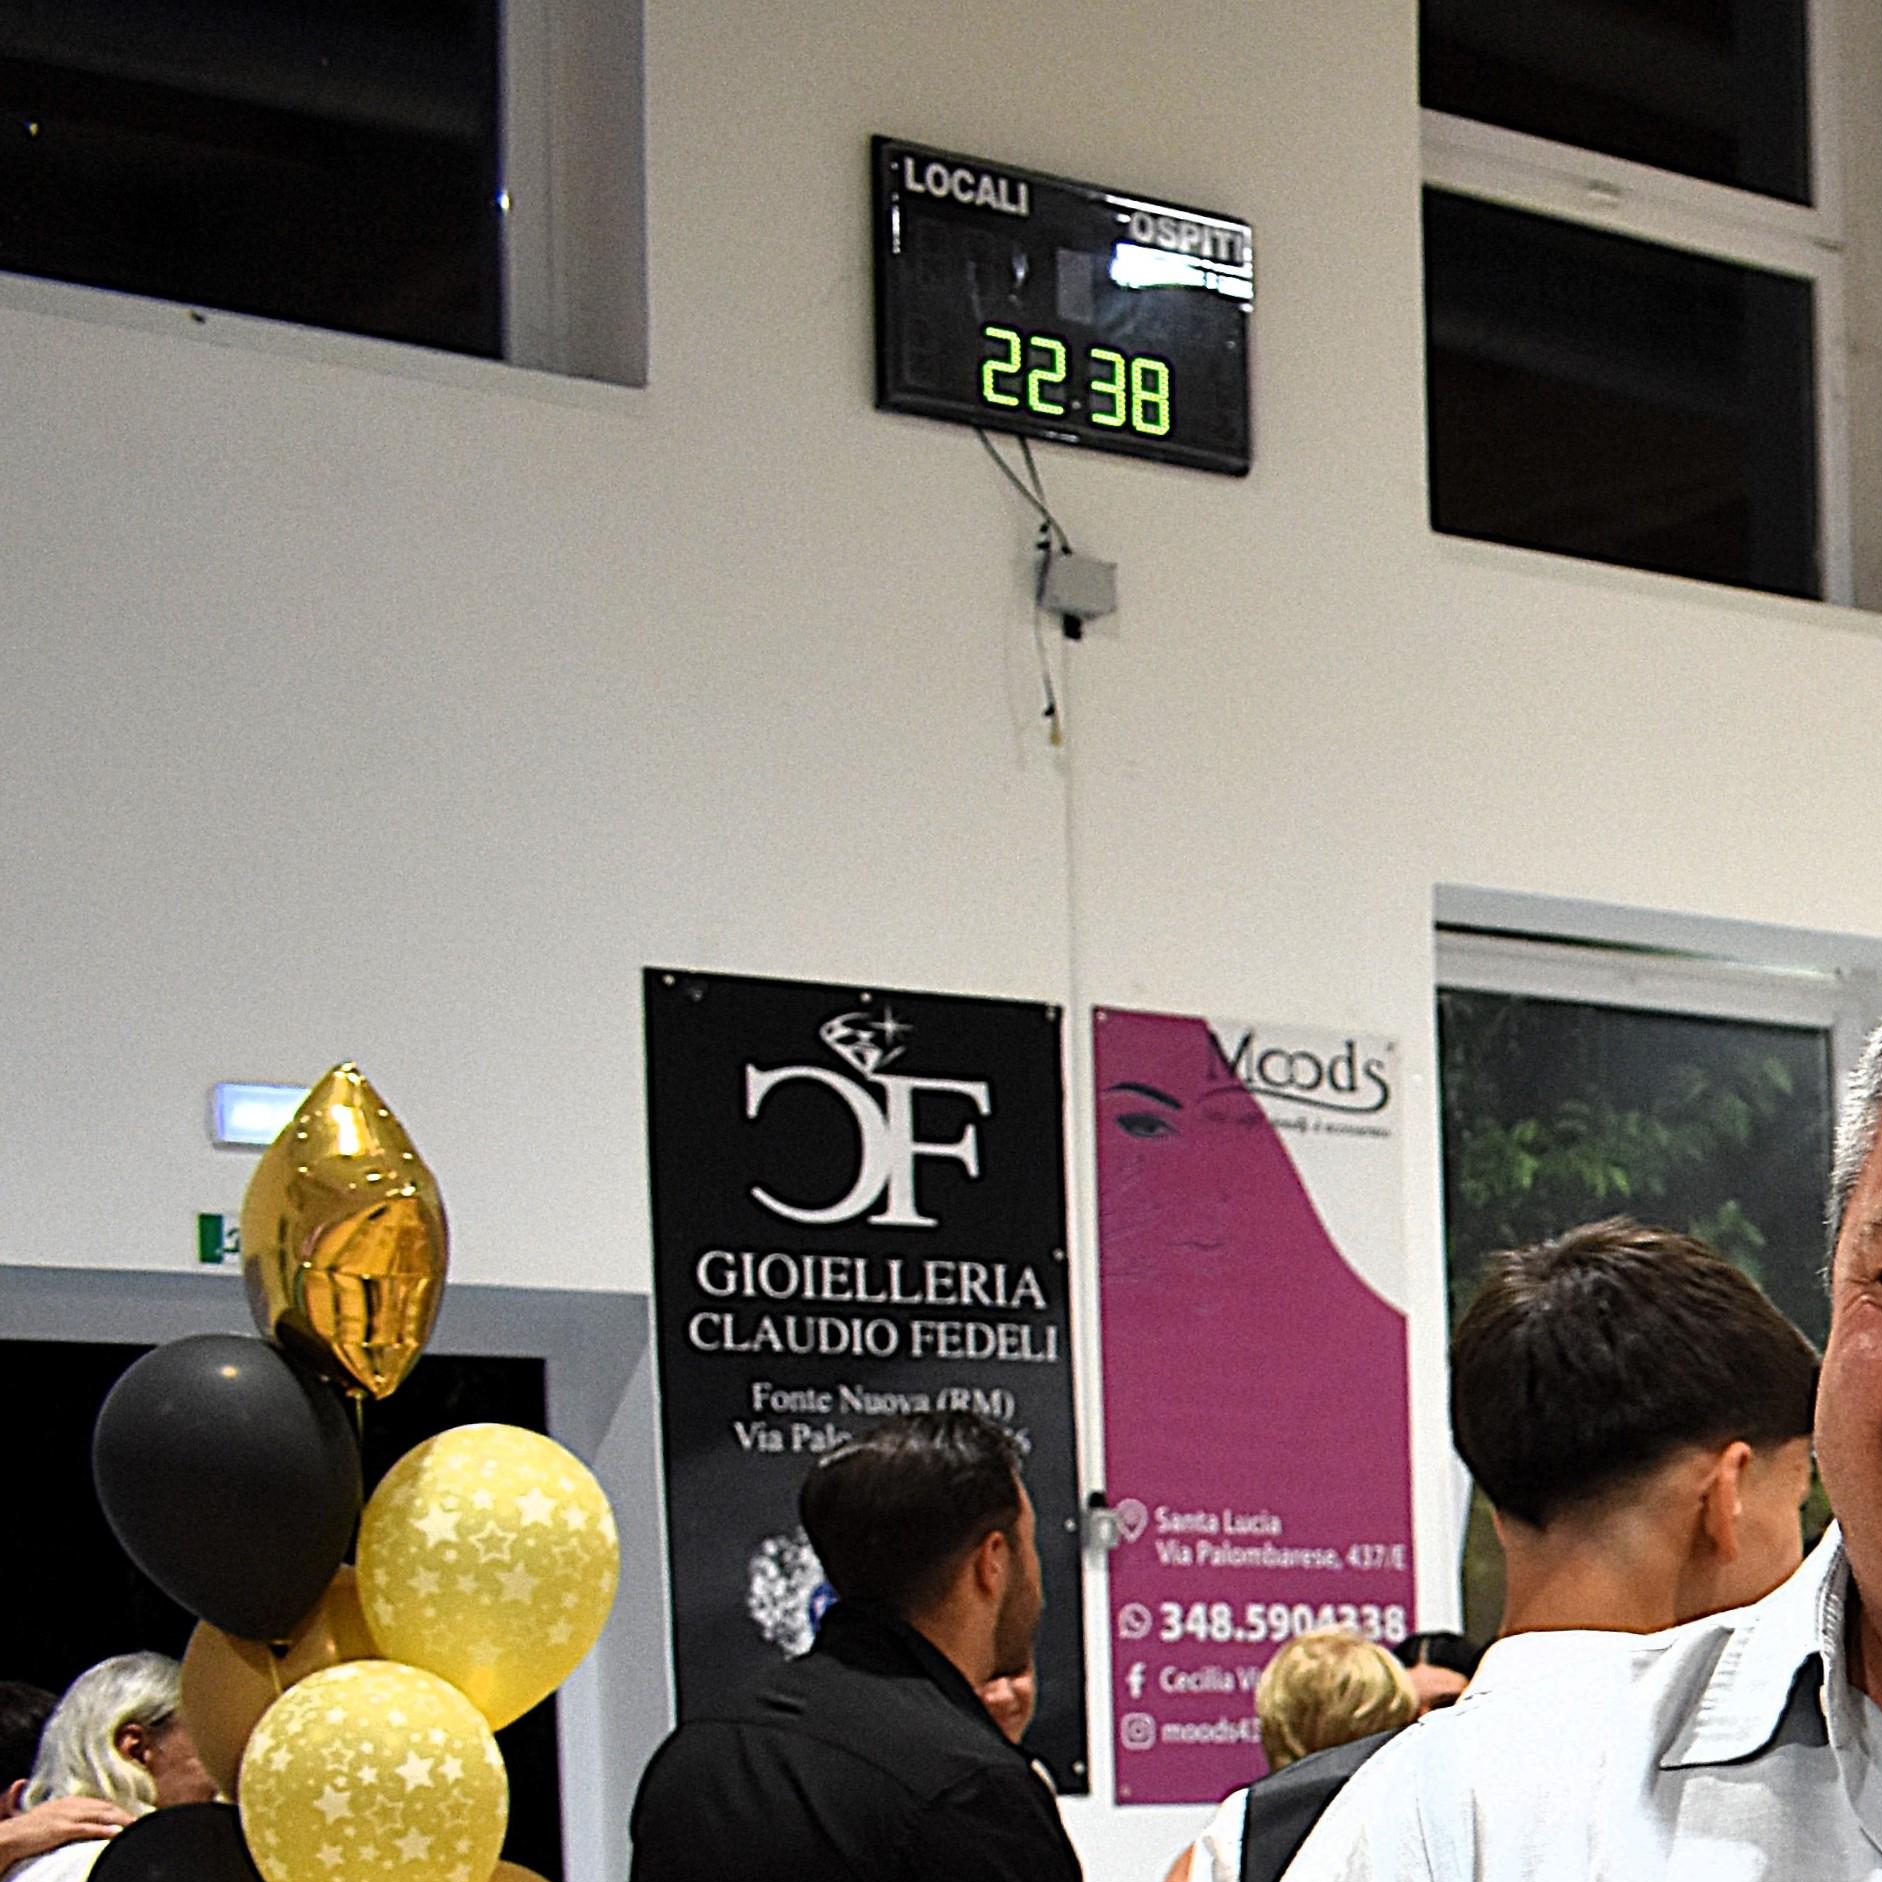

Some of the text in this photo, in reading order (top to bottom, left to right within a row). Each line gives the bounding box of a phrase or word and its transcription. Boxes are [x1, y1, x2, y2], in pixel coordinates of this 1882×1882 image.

[905, 157, 1030, 217] LOCALI
[1130, 212, 1243, 261] OSPITI
[696, 1250, 1047, 1311] GIOIELLERIA
[689, 1312, 1059, 1362] CLAUDIO FEDELI
[751, 1381, 833, 1414] Fonte
[838, 1383, 931, 1415] Nuova
[733, 1421, 785, 1452] Via
[1155, 1506, 1282, 1536] Santa Lucia
[1155, 1540, 1193, 1567] Via
[1159, 1665, 1233, 1693] Cecilia
